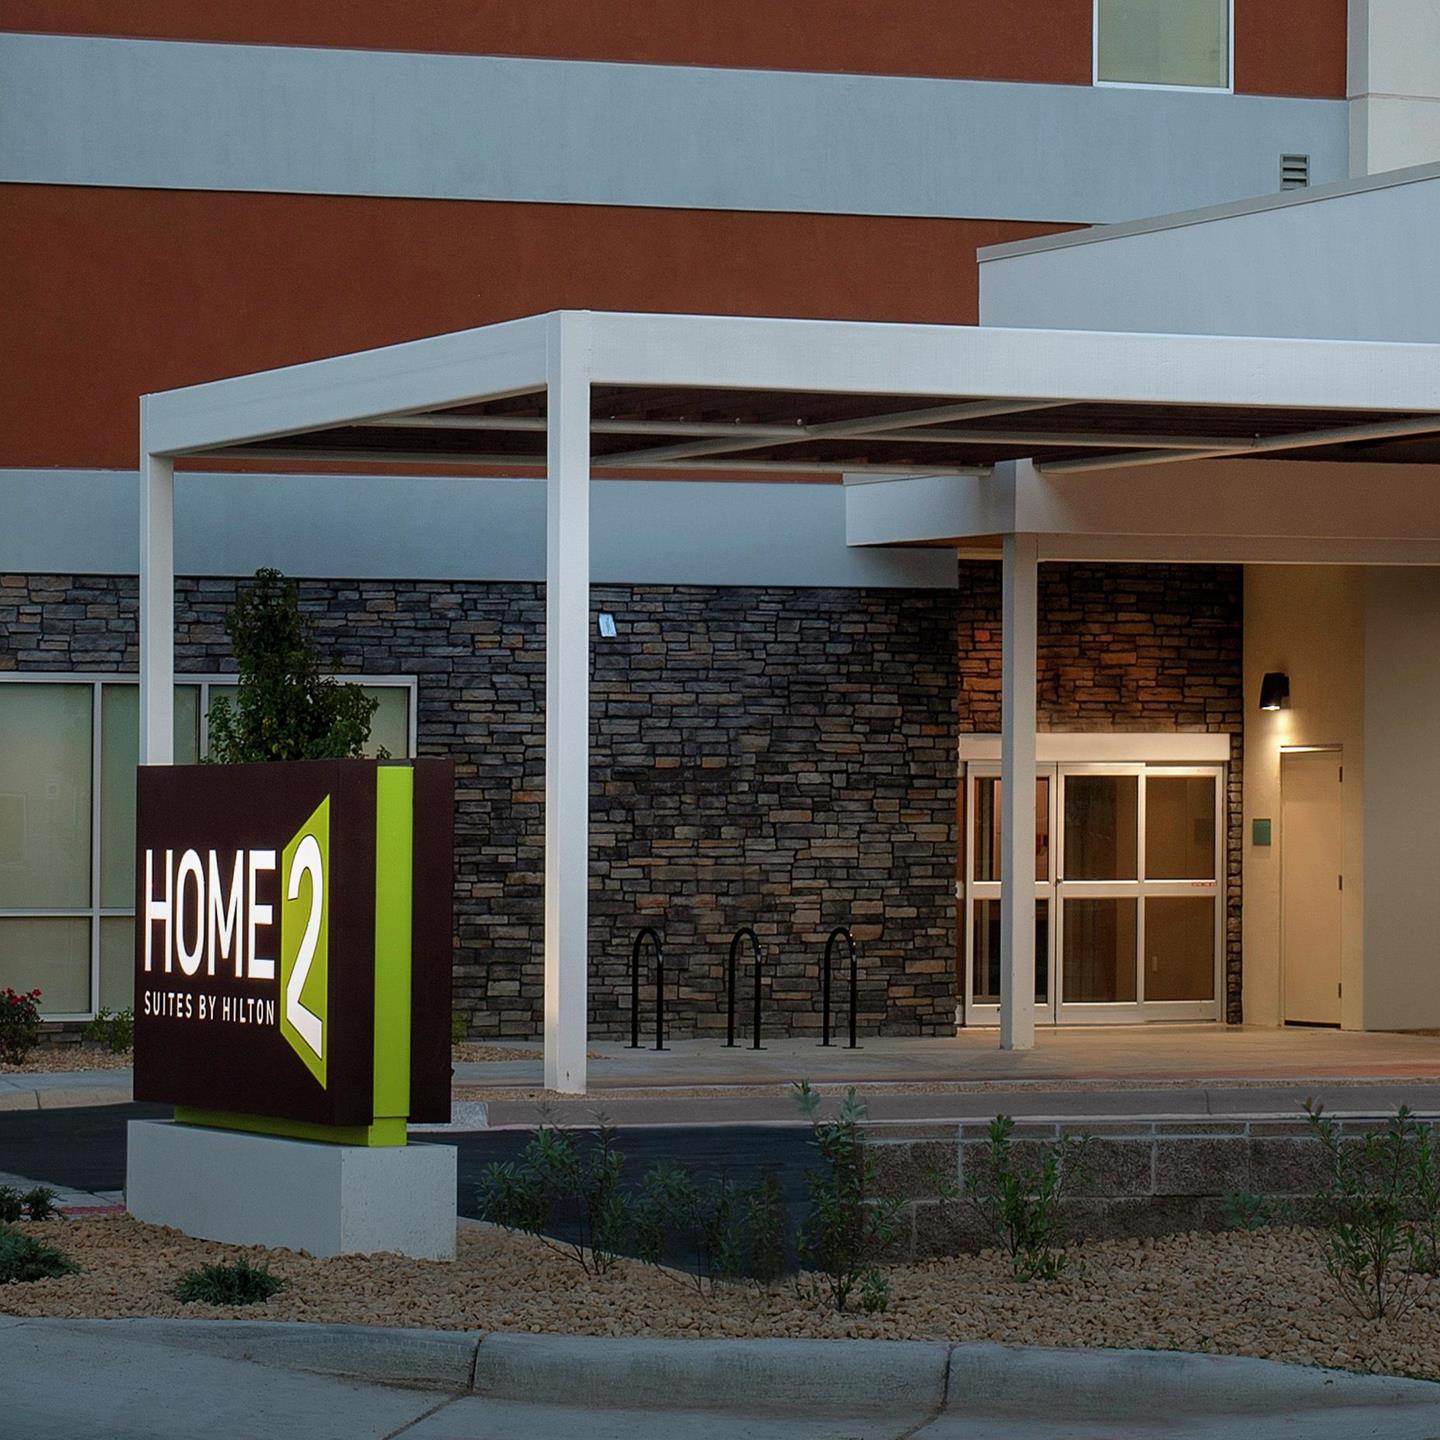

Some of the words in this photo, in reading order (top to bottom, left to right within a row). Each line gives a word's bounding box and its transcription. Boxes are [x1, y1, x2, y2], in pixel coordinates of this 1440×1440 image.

[144, 990, 192, 1019] SUITES
[198, 994, 216, 1021] BY
[222, 996, 275, 1026] HILTON
